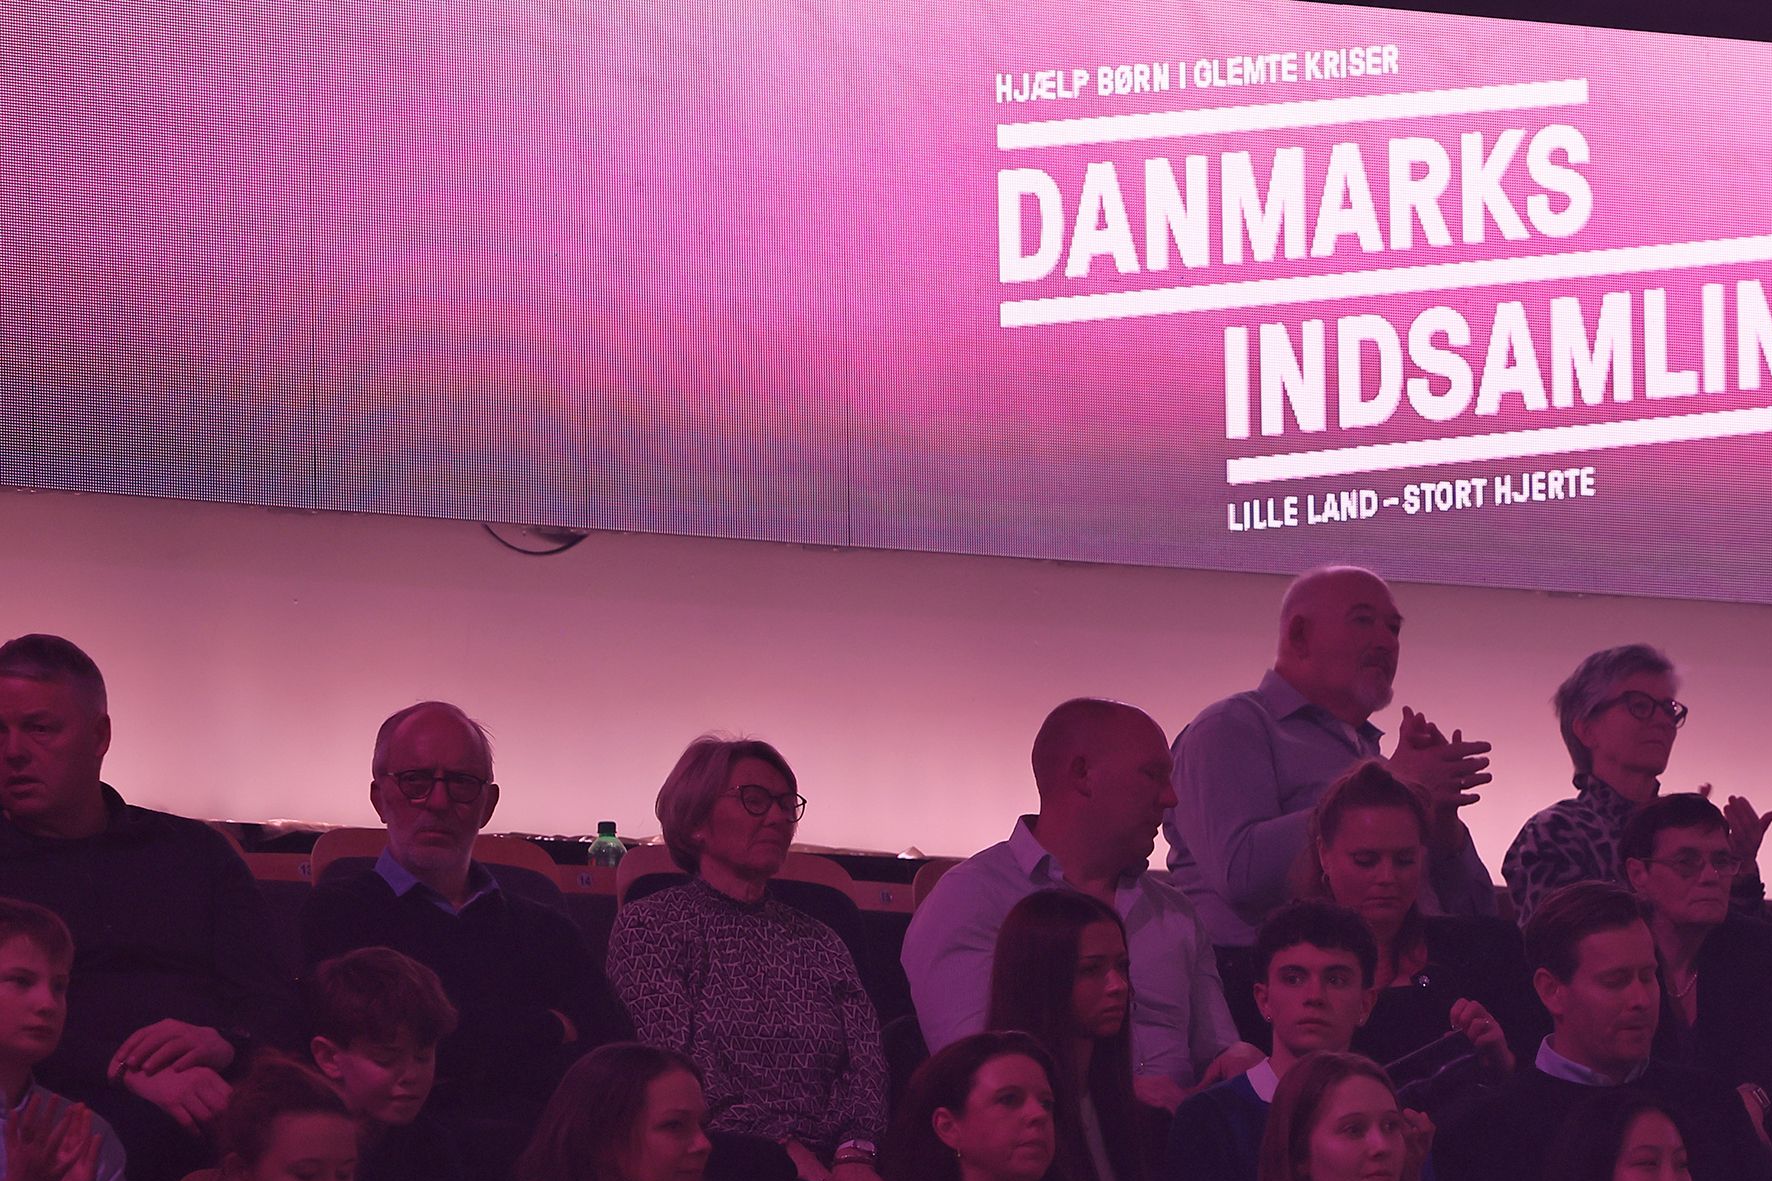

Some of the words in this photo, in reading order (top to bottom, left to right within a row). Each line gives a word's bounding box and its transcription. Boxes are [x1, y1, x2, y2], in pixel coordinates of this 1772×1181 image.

[996, 69, 1090, 104] HJÆLP
[1098, 61, 1170, 97] BØRN
[1179, 61, 1187, 90] I
[1194, 52, 1298, 89] GLEMTE
[1305, 44, 1400, 81] KRISER
[998, 124, 1593, 283] DANMARKS
[1228, 496, 1298, 532] LILLE
[1494, 466, 1596, 506] HJERTE
